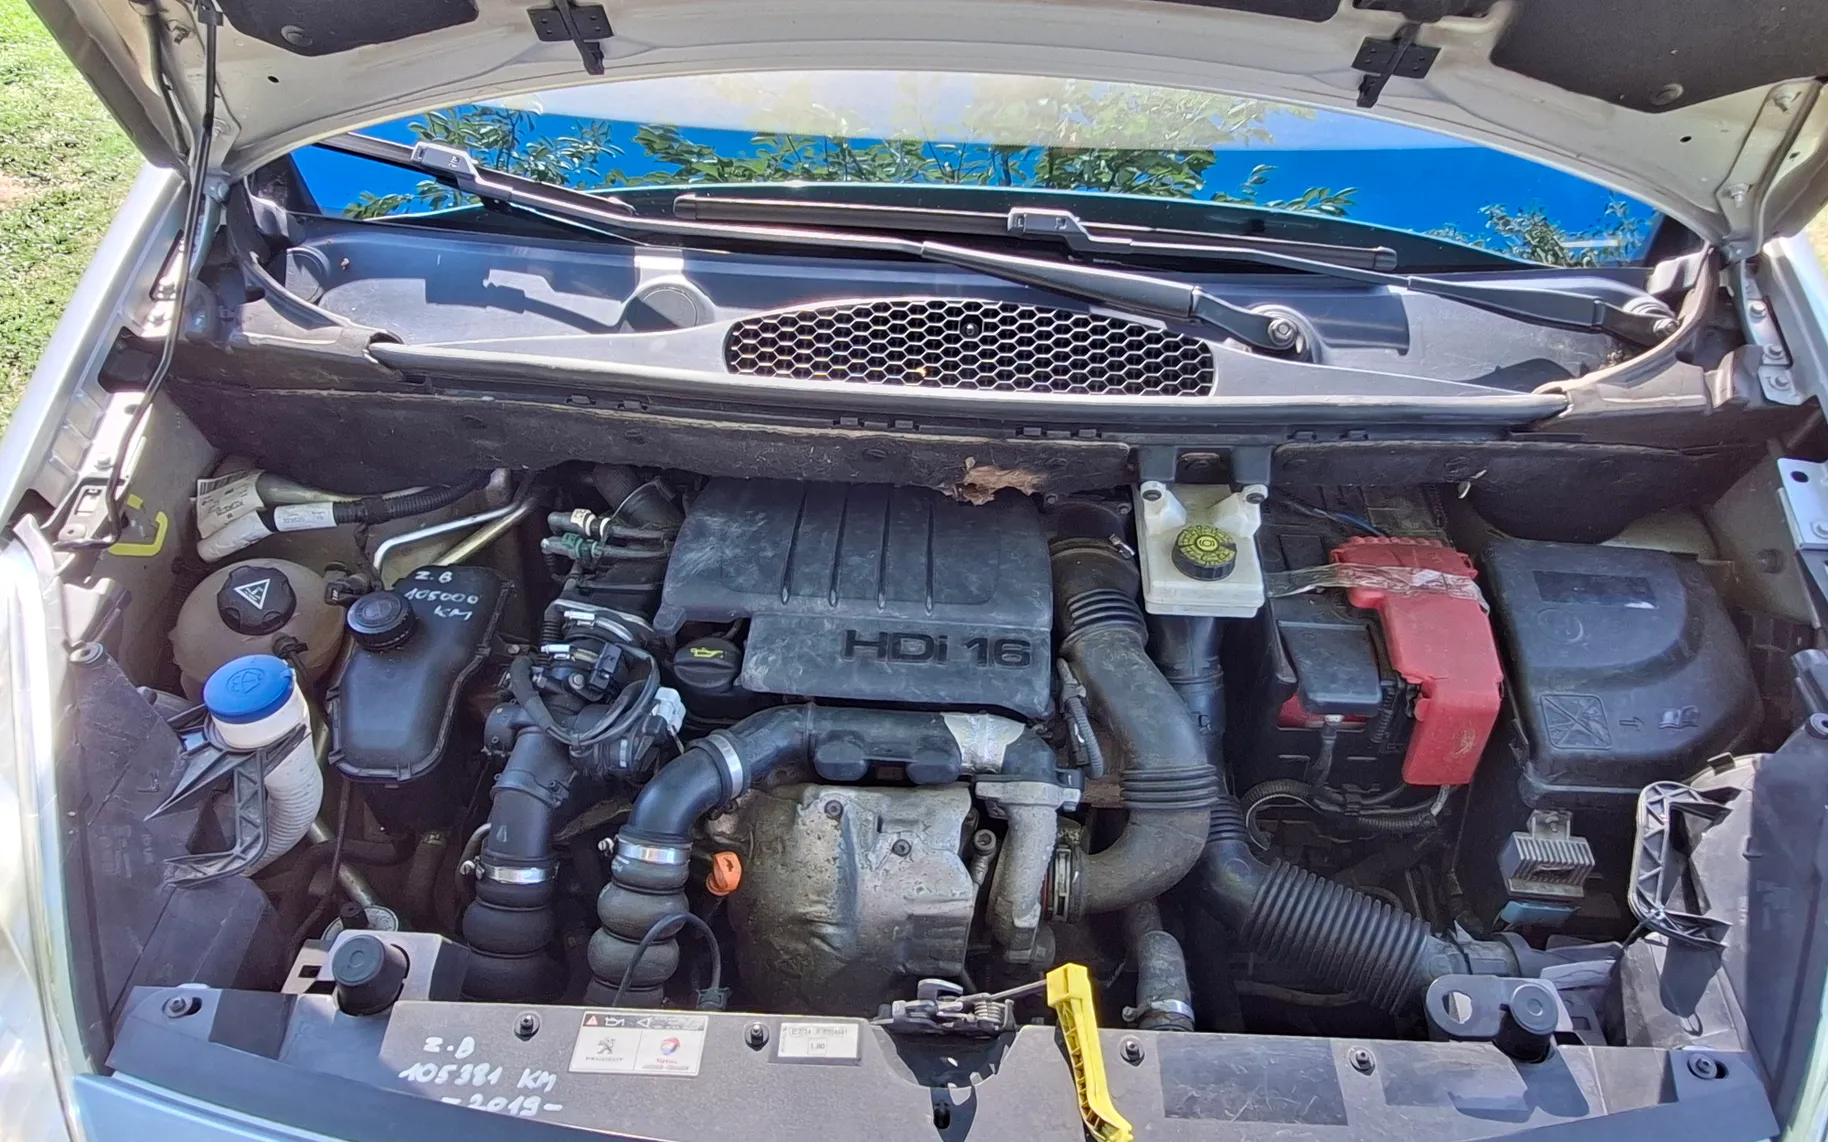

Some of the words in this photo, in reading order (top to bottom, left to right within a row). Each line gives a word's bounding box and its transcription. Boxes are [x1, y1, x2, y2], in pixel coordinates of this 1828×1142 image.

[404, 588, 479, 604] 105000
[434, 605, 473, 621] KM
[842, 629, 948, 666] HDi
[961, 637, 1032, 668] 16
[398, 1062, 503, 1087] 105381
[517, 1067, 557, 1093] KM
